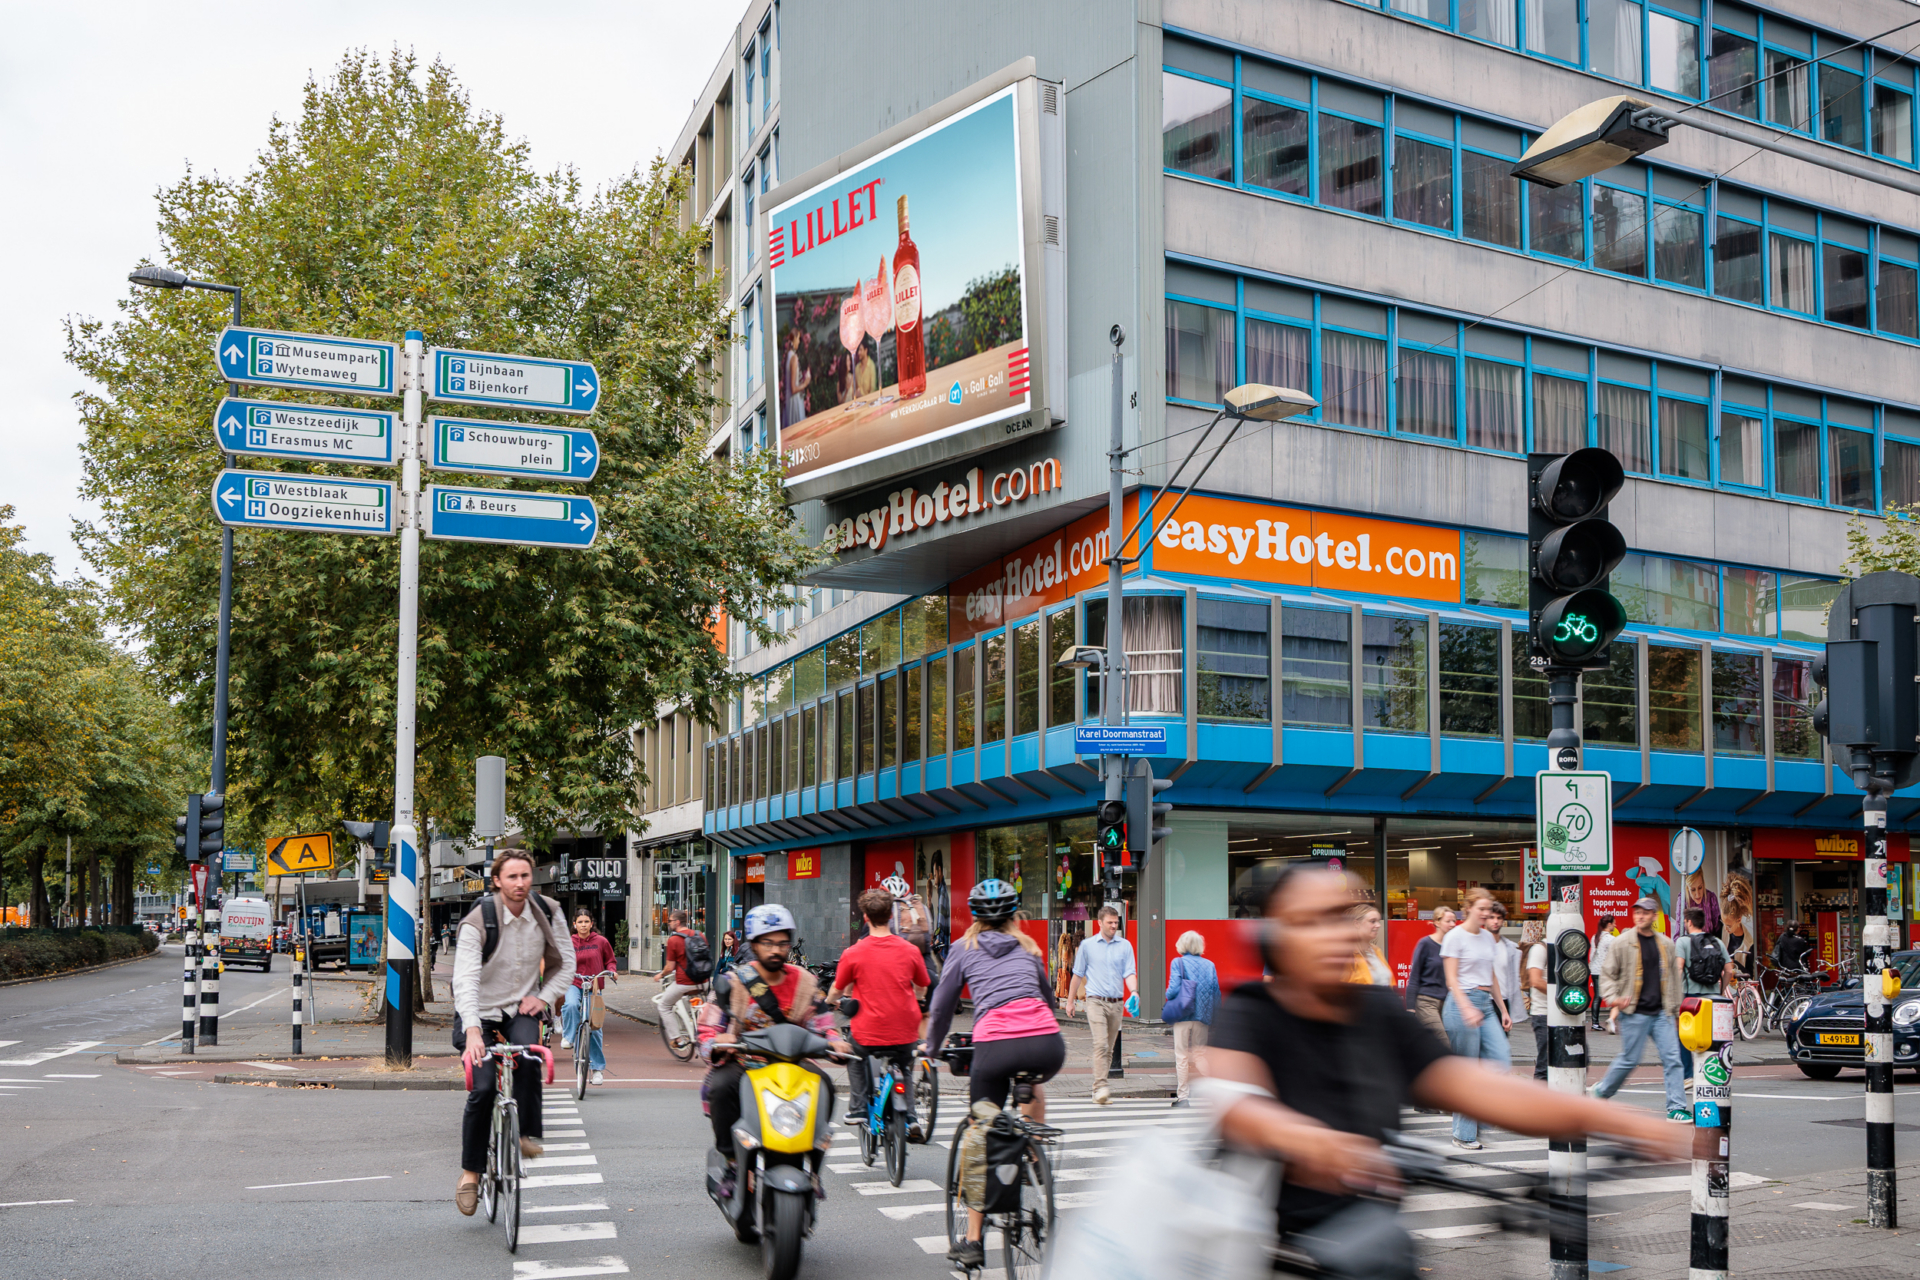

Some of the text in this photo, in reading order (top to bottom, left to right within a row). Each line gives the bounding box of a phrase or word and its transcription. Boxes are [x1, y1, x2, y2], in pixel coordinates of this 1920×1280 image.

[791, 178, 881, 258] LILLET
[867, 287, 883, 302] LILLET
[895, 285, 918, 304] LILLET
[292, 346, 378, 365] Museumpark
[276, 362, 357, 382] Wytemaweg
[469, 362, 524, 378] Lijnbaan
[469, 380, 529, 395] Bijenkorf
[275, 412, 359, 432] Westzeedijk
[1006, 418, 1032, 434] OCEAN
[271, 433, 328, 448] Erasmus
[333, 438, 353, 450] MC
[468, 430, 553, 450] Schouwburg-
[521, 453, 553, 466] plein
[274, 484, 348, 499] Westblaak
[269, 502, 384, 523] Oogziekenhuis
[480, 500, 517, 513] Beurs
[823, 457, 1062, 553] easyHotel.com
[1158, 518, 1456, 581] easyHotel.com
[1530, 656, 1551, 665] 28.1
[1079, 729, 1162, 739] Karel Doormanstraat
[1566, 815, 1585, 830] 70
[1815, 834, 1858, 852] wibra
[298, 843, 318, 864] A
[1312, 848, 1346, 856] OPRUIMING
[587, 860, 621, 878] SUGO
[796, 852, 812, 871] wibra
[1606, 877, 1615, 885] Dé
[1589, 887, 1632, 896] schoonmaak-
[1593, 899, 1615, 908] topper
[228, 916, 265, 926] FONTIJN
[1823, 1035, 1855, 1043] L-491-BX
